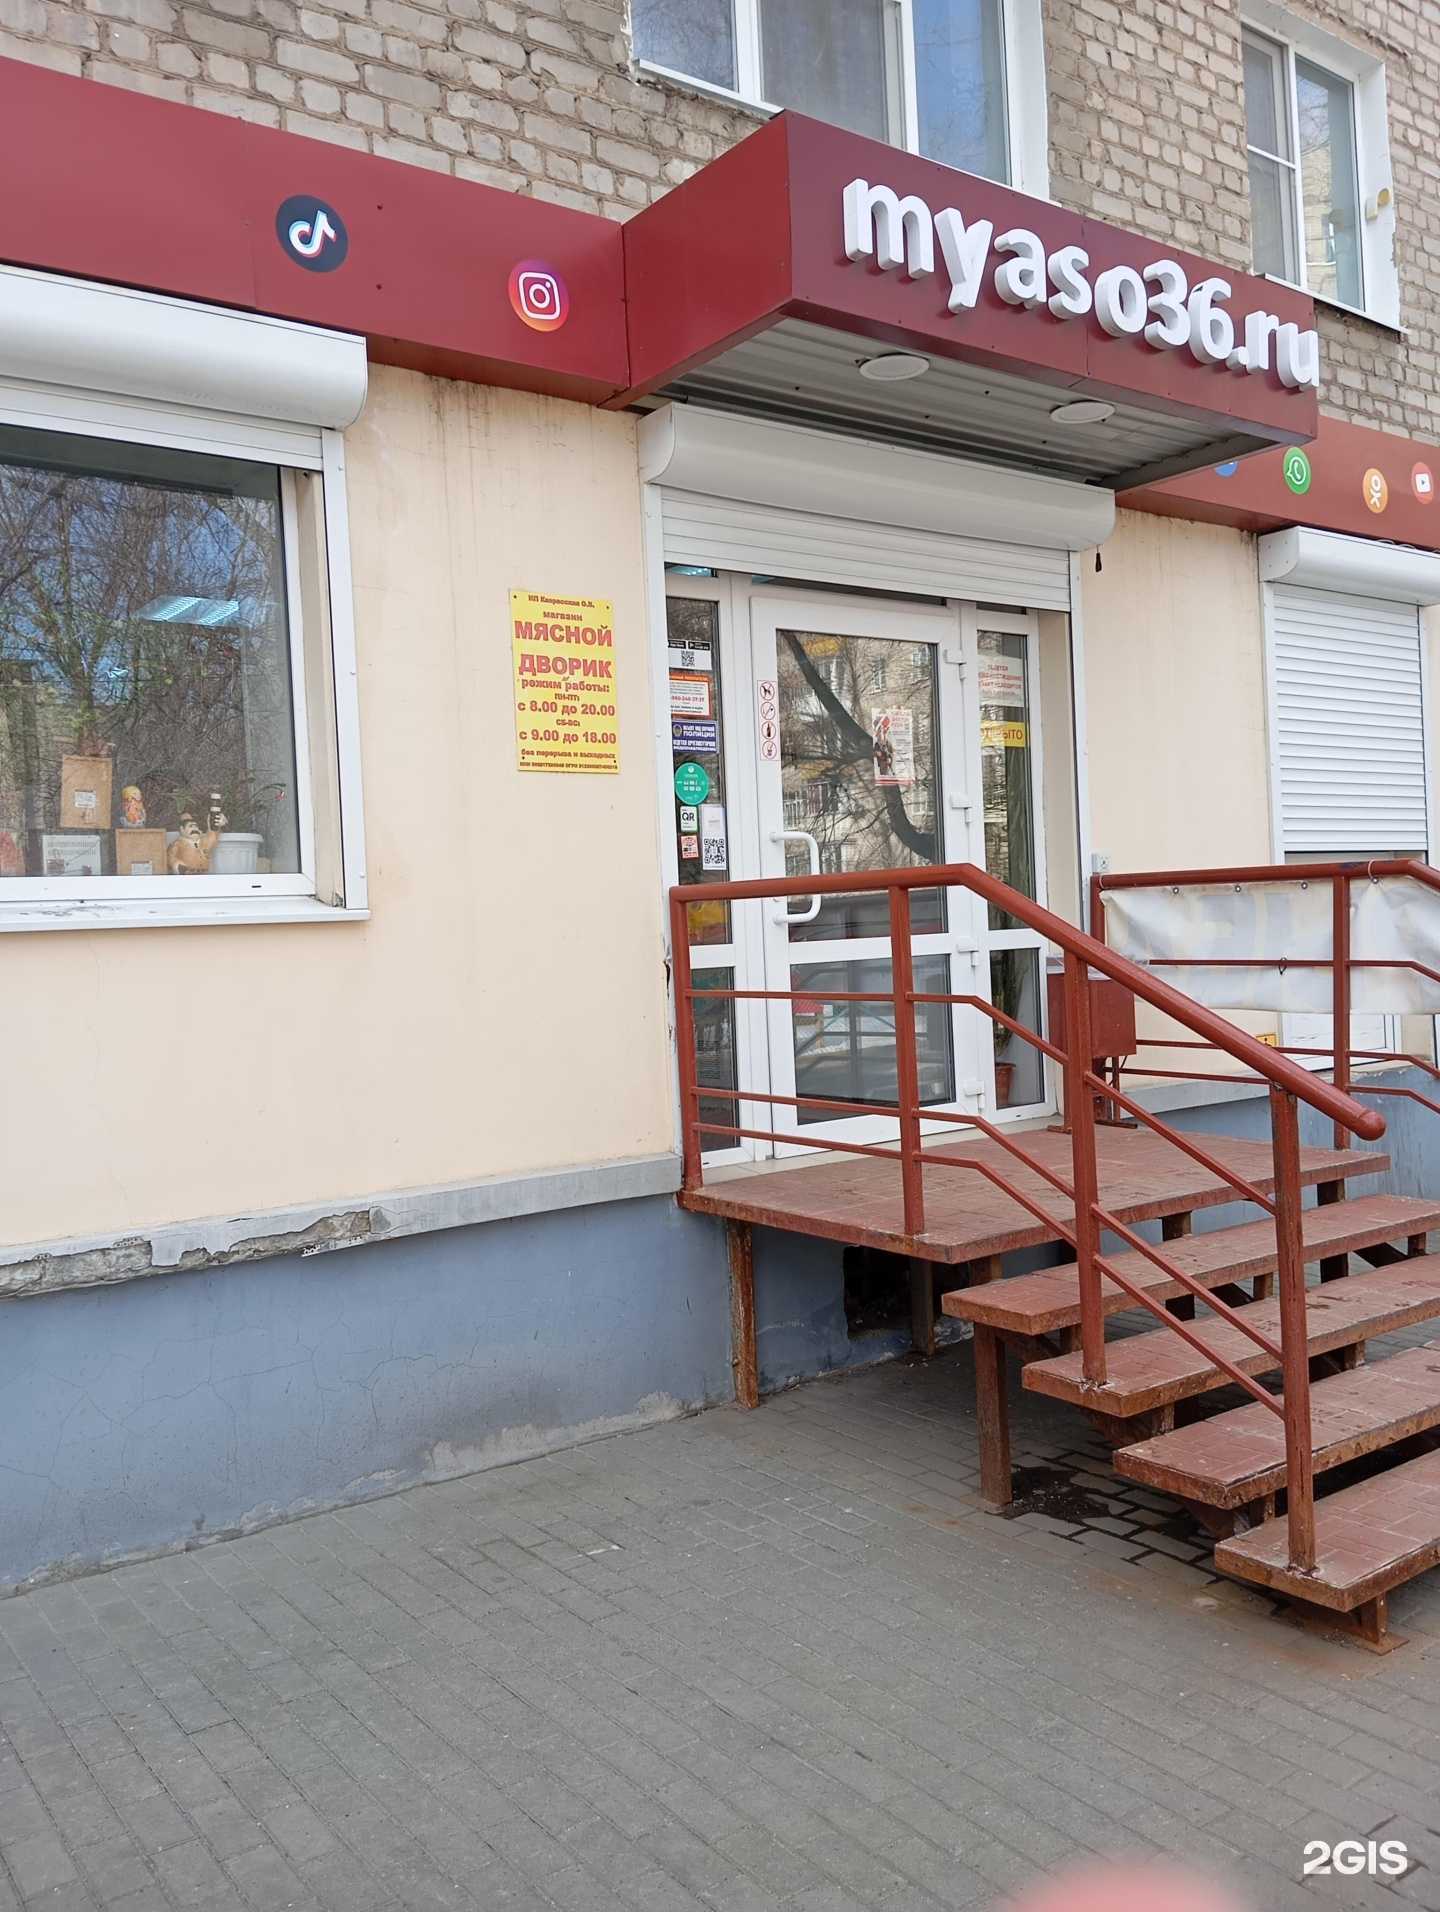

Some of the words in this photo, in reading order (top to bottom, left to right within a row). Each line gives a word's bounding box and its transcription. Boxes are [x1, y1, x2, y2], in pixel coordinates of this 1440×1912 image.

[843, 178, 1320, 389] myaso36.ru
[514, 620, 613, 647] МЯСНОЙ
[518, 653, 612, 679] ДВОРИК
[565, 680, 610, 693] работы:
[517, 701, 526, 712] с
[530, 700, 558, 713] 8.00
[561, 705, 577, 716] до
[581, 703, 615, 717] 20.00
[519, 730, 527, 741] с
[531, 729, 559, 742] 9.00
[562, 733, 579, 744] до
[582, 731, 617, 744] 18.00
[681, 812, 695, 822] QR
